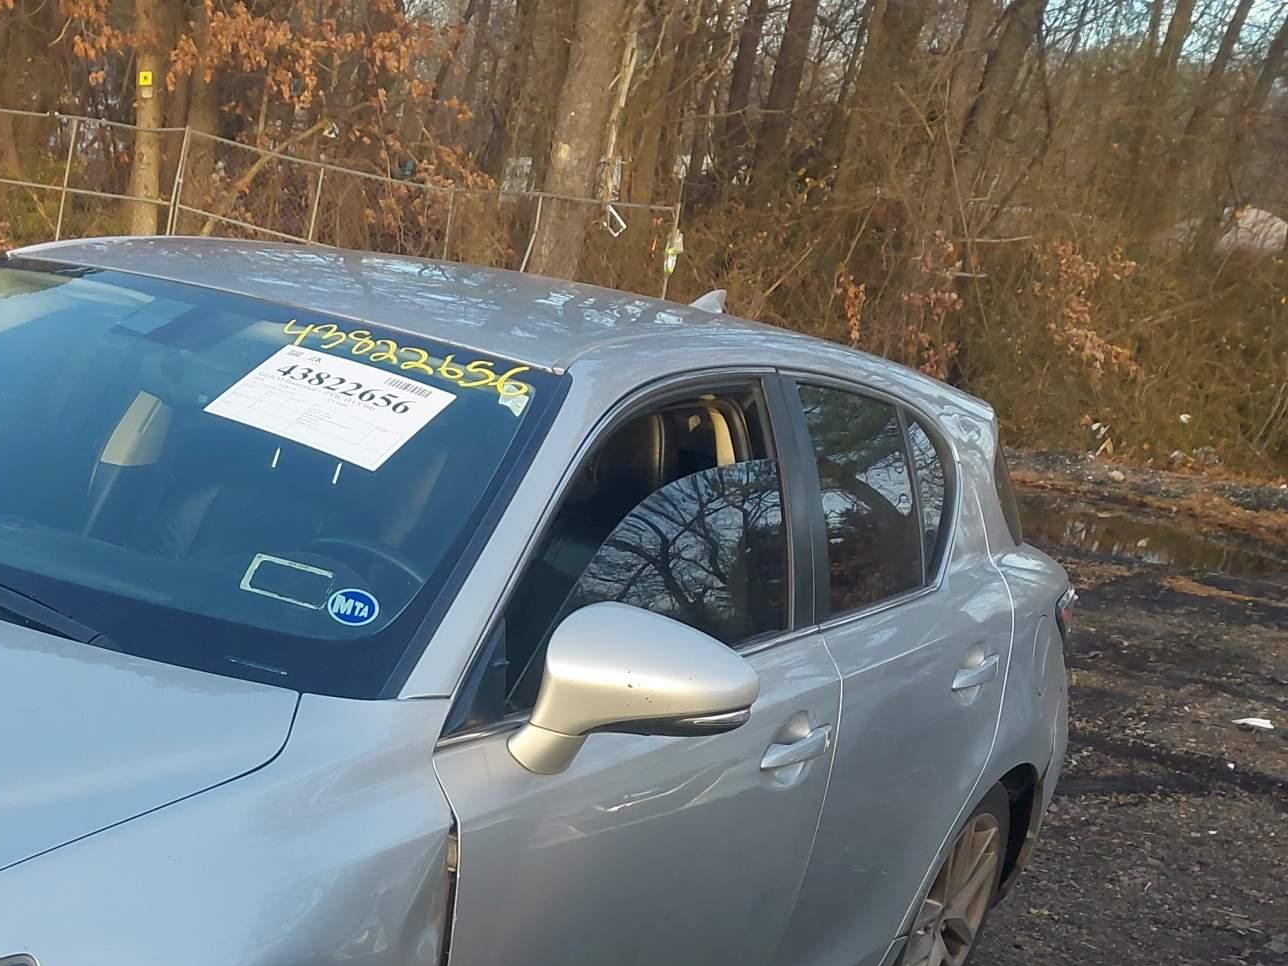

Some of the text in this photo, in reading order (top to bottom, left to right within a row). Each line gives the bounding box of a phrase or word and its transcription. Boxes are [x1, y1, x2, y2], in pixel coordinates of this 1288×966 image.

[283, 319, 530, 396] 43822656
[276, 364, 417, 414] 43822656
[333, 594, 369, 618] MTA
